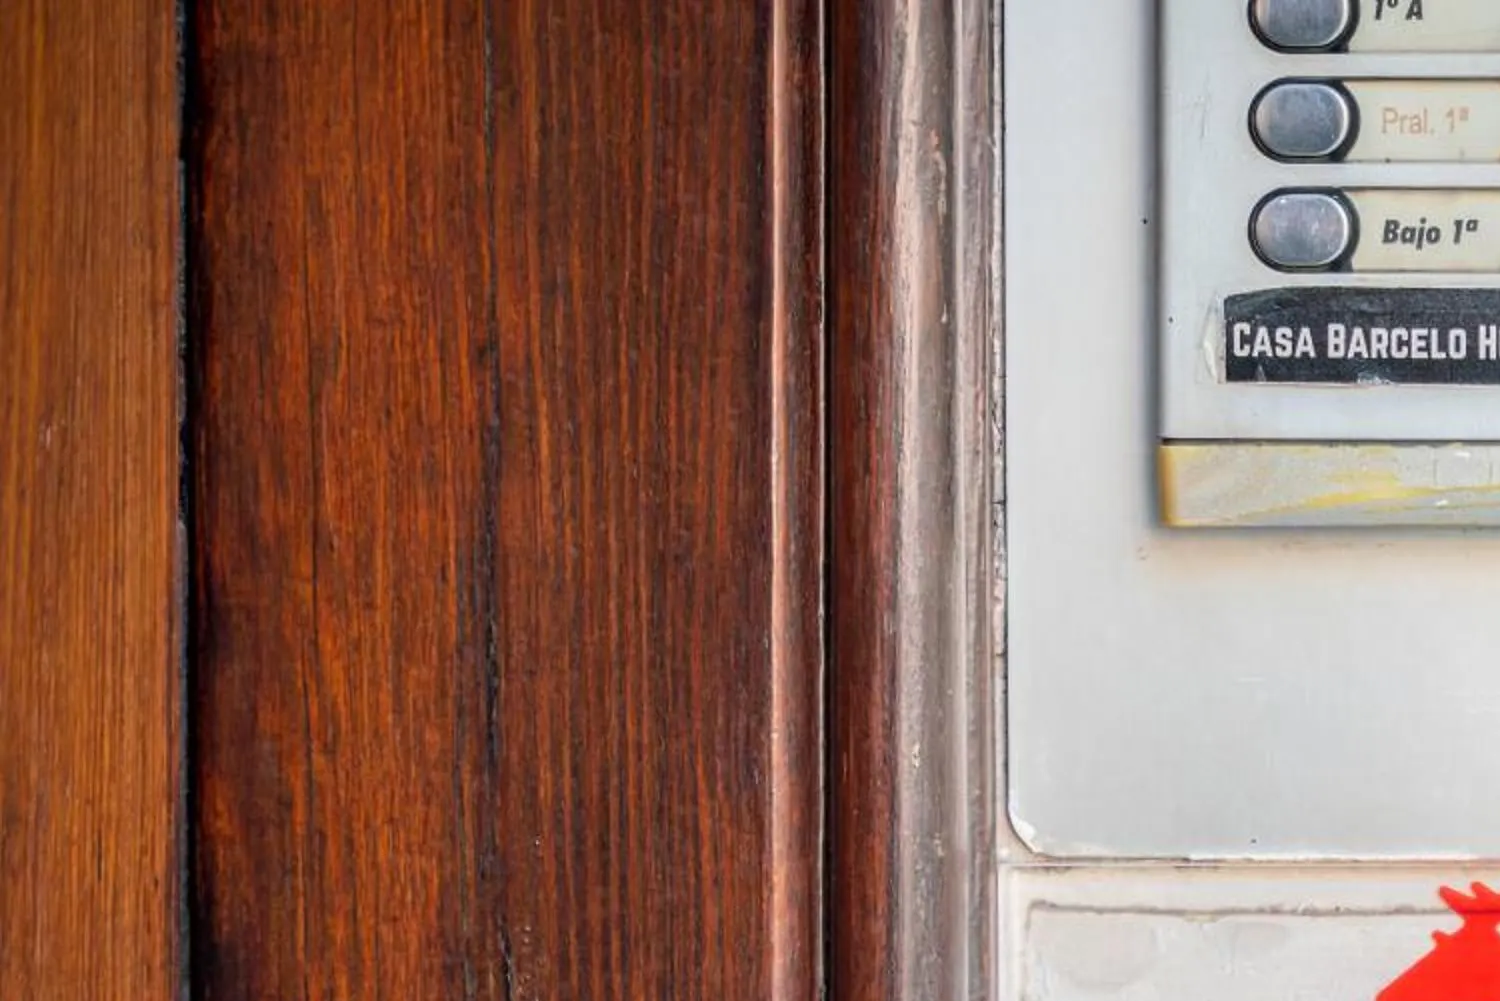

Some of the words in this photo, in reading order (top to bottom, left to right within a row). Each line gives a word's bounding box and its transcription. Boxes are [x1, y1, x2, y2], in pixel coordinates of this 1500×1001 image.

[1404, 0, 1423, 21] A
[1381, 106, 1435, 134] Pral.
[1382, 217, 1442, 250] Bajo
[1233, 322, 1315, 358] CASA
[1327, 323, 1467, 359] BARCELO
